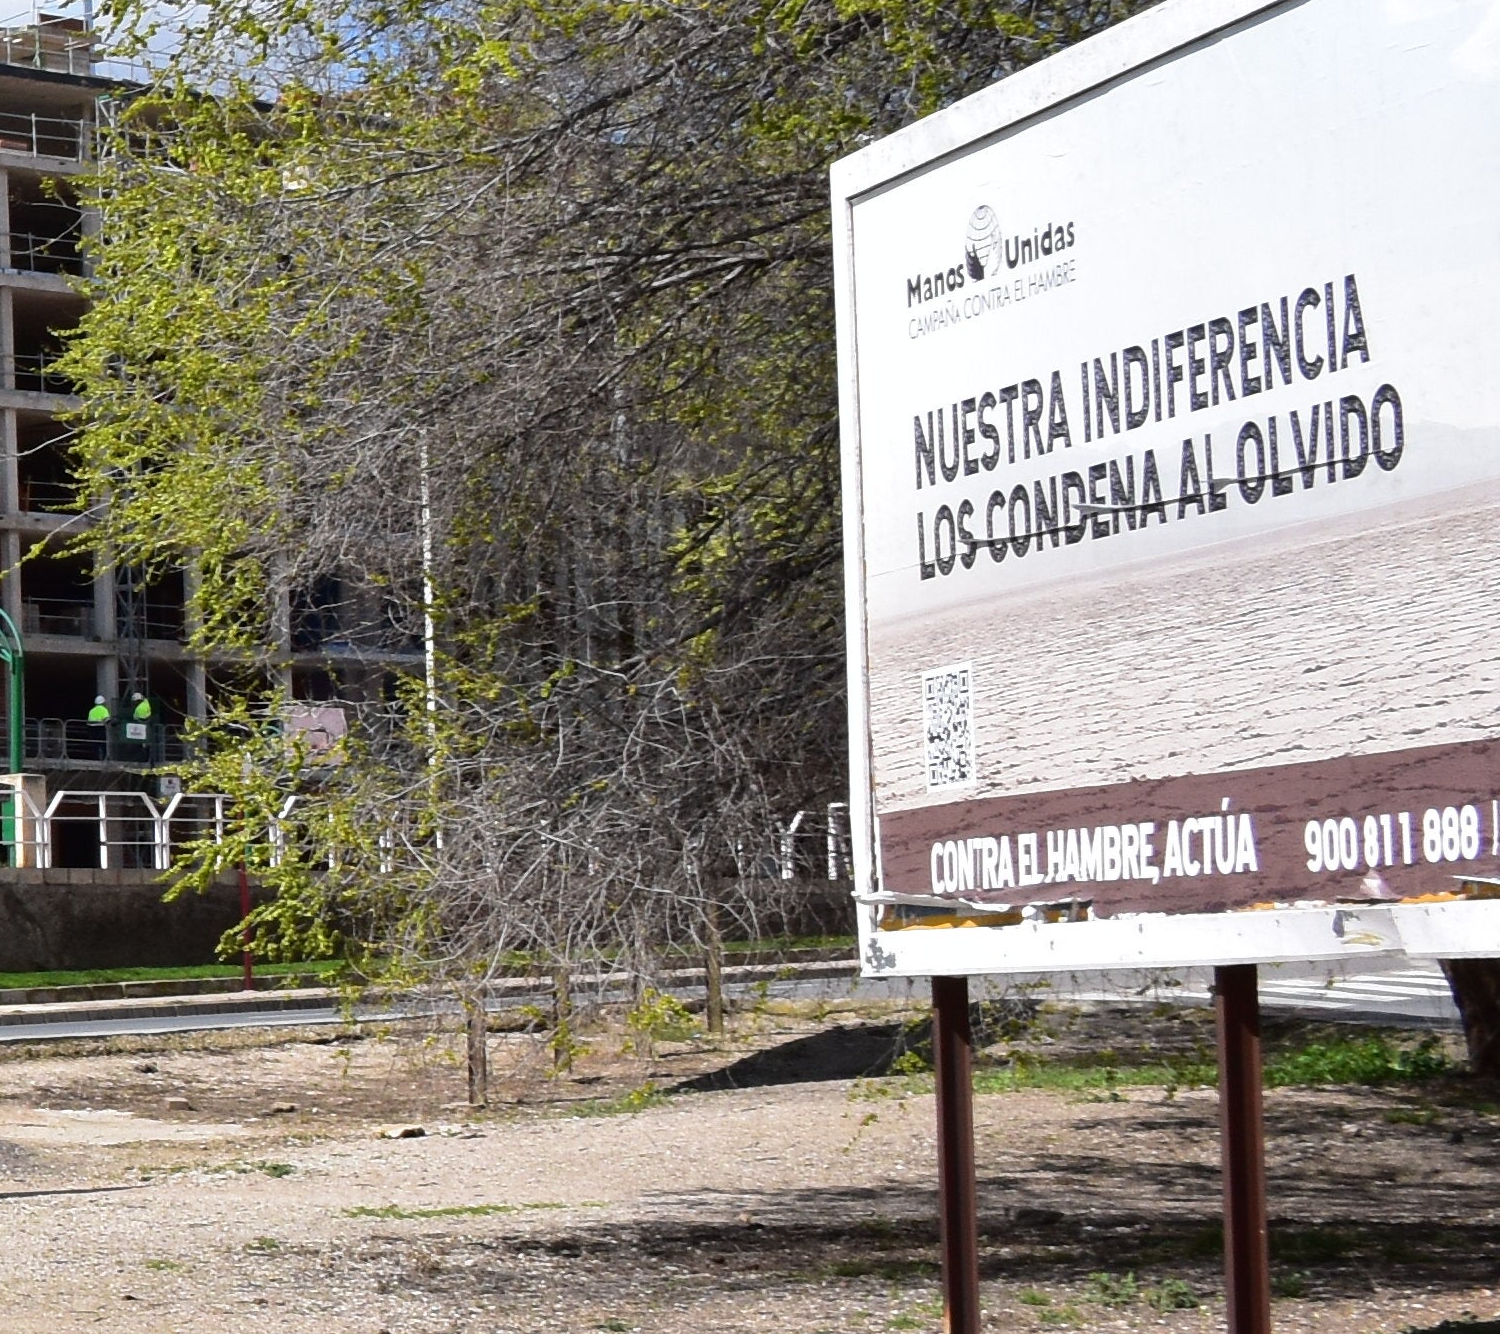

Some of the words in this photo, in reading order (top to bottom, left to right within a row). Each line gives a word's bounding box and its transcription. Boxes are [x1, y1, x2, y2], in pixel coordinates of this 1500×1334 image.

[906, 263, 966, 309] Manos
[1004, 220, 1077, 270] Unidas
[963, 284, 1012, 320] CONTRA
[1014, 278, 1027, 303] EL
[1029, 258, 1077, 298] HAMBRE
[911, 368, 1071, 493] NUESTRA
[1081, 272, 1370, 443] INDIFERENCIA
[916, 496, 977, 582] LOS
[985, 448, 1169, 566] CONDENA
[1175, 432, 1228, 521] AL
[1236, 382, 1405, 505] OLVIDO
[930, 835, 1016, 895] CONTRA
[1017, 832, 1045, 887] EL
[1045, 821, 1161, 885] HAMBRE,
[1163, 797, 1260, 878] ACTÚA
[1304, 817, 1358, 873] 900
[1363, 811, 1413, 868] 811
[1422, 804, 1480, 864] 888
